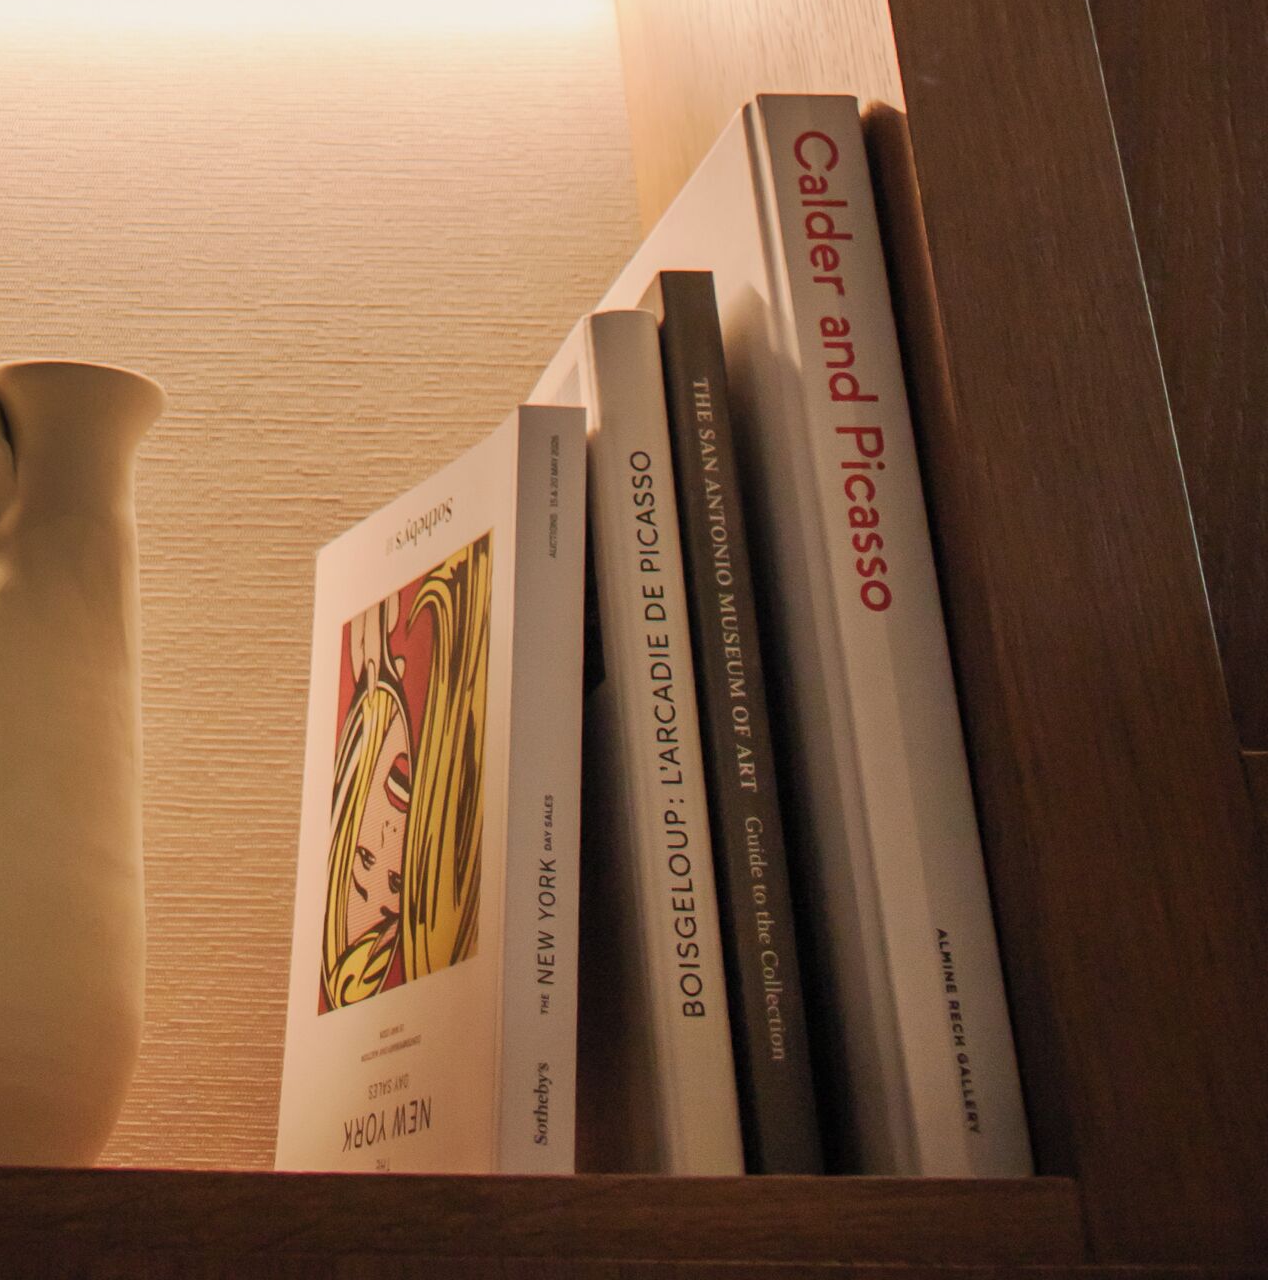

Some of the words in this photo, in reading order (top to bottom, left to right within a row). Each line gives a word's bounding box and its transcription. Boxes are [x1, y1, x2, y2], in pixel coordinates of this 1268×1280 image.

[790, 130, 862, 297] Calder
[817, 316, 881, 402] and
[693, 377, 714, 423] THE
[699, 428, 719, 471] SAN
[395, 496, 454, 551] Sotheby's
[630, 449, 663, 572] PICASSO
[704, 478, 733, 586] ANTONIO
[834, 425, 910, 610] Picasso
[641, 584, 667, 621] DE
[717, 592, 746, 697] MUSEUM
[645, 634, 683, 784] L'ARCADIE
[729, 705, 751, 740] OF
[733, 743, 757, 792] ART
[542, 793, 553, 829] SALES
[542, 830, 553, 851] DAY
[744, 816, 768, 876] Guide
[536, 857, 556, 919] YORK
[661, 797, 707, 1018] BOISGELOUP:
[751, 880, 770, 900] to
[754, 906, 776, 941] the
[536, 928, 555, 985] NEW
[936, 928, 960, 995] ALMINE
[539, 994, 549, 1014] THE
[758, 945, 791, 1058] Collection
[946, 999, 968, 1047] RECH
[367, 1078, 392, 1100] SALES
[394, 1073, 409, 1092] DAY
[531, 1061, 553, 1146] Sotheby's
[954, 1051, 981, 1134] GALLERY
[342, 1109, 386, 1153] YORK
[392, 1095, 432, 1140] NEW
